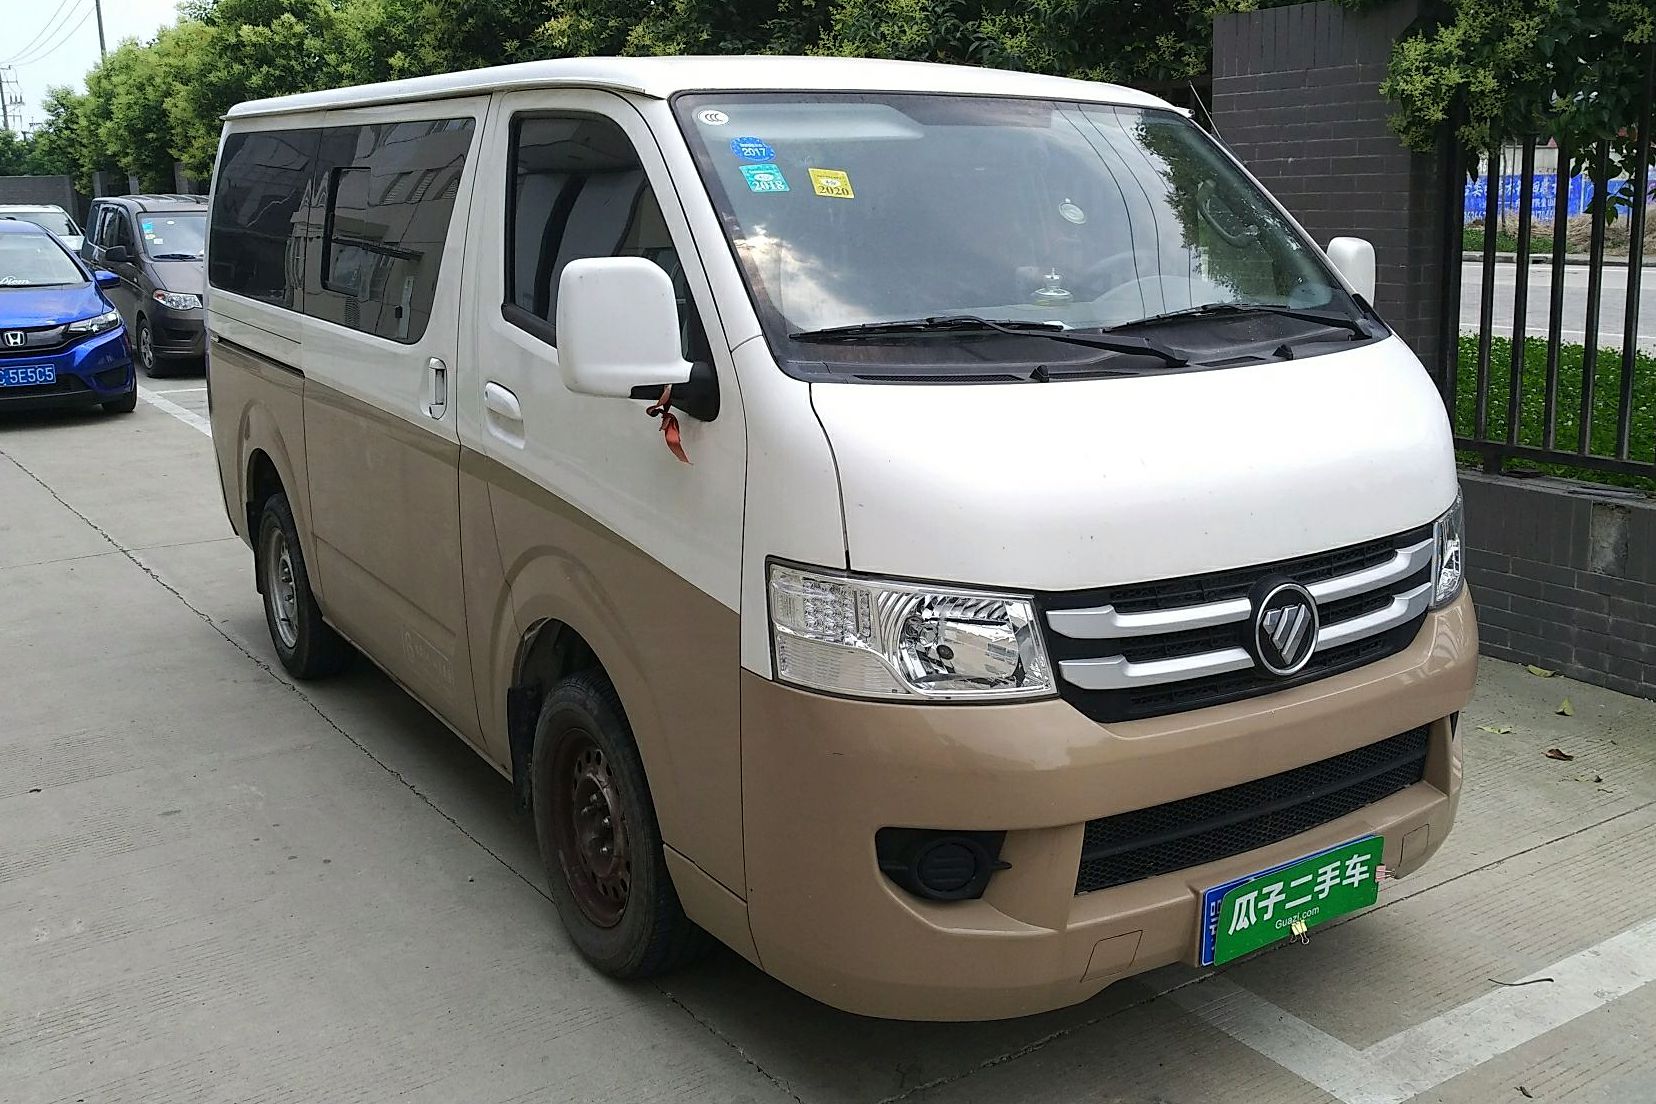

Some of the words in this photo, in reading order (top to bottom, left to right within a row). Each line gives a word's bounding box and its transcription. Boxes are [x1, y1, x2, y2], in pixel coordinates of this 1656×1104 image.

[741, 147, 766, 157] 2017
[752, 180, 785, 191] 2018
[819, 185, 849, 196] 2020
[1228, 854, 1371, 936] 瓜子二手车
